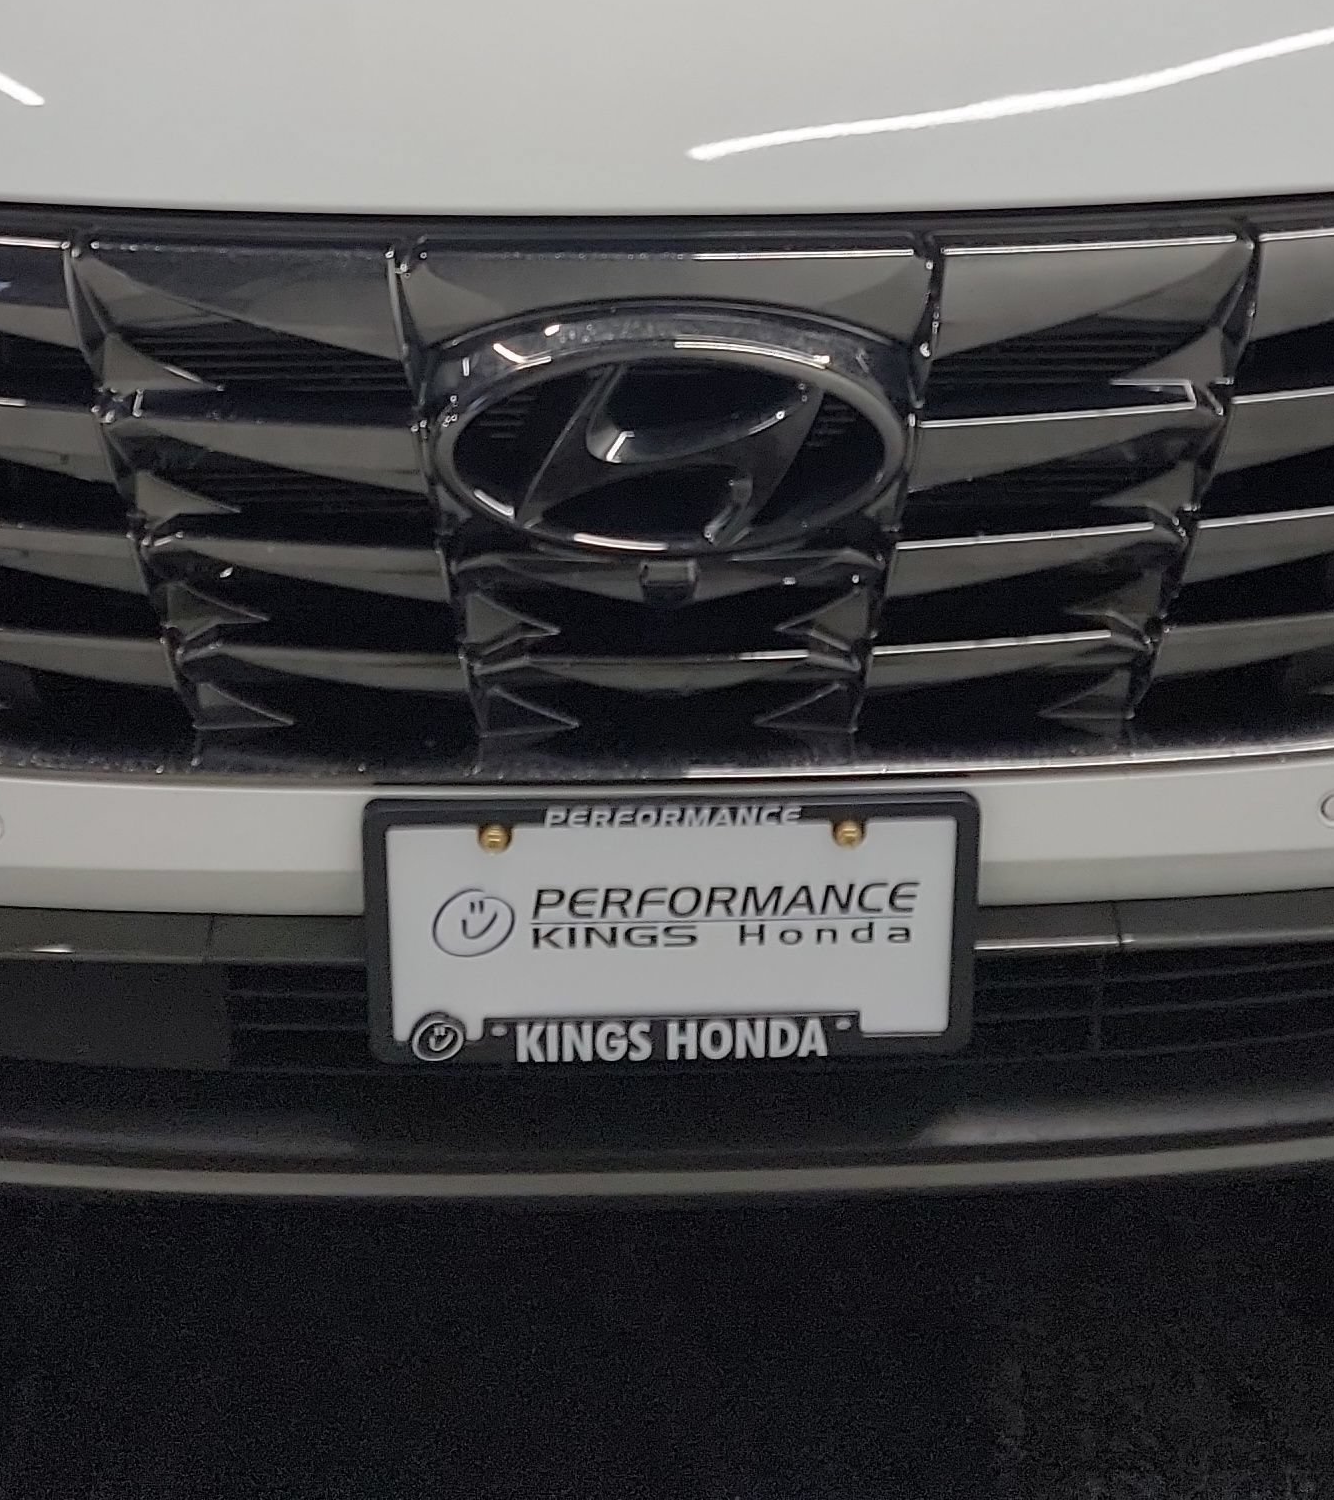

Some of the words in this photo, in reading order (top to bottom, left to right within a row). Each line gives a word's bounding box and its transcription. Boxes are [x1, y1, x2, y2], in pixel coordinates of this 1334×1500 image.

[543, 804, 802, 828] PERFORMANCE
[531, 882, 921, 919] PERFORMANCE
[531, 925, 699, 949] KINGS
[738, 924, 913, 946] Honda
[515, 1021, 653, 1063] KINGS
[667, 1018, 828, 1061] HONDA
